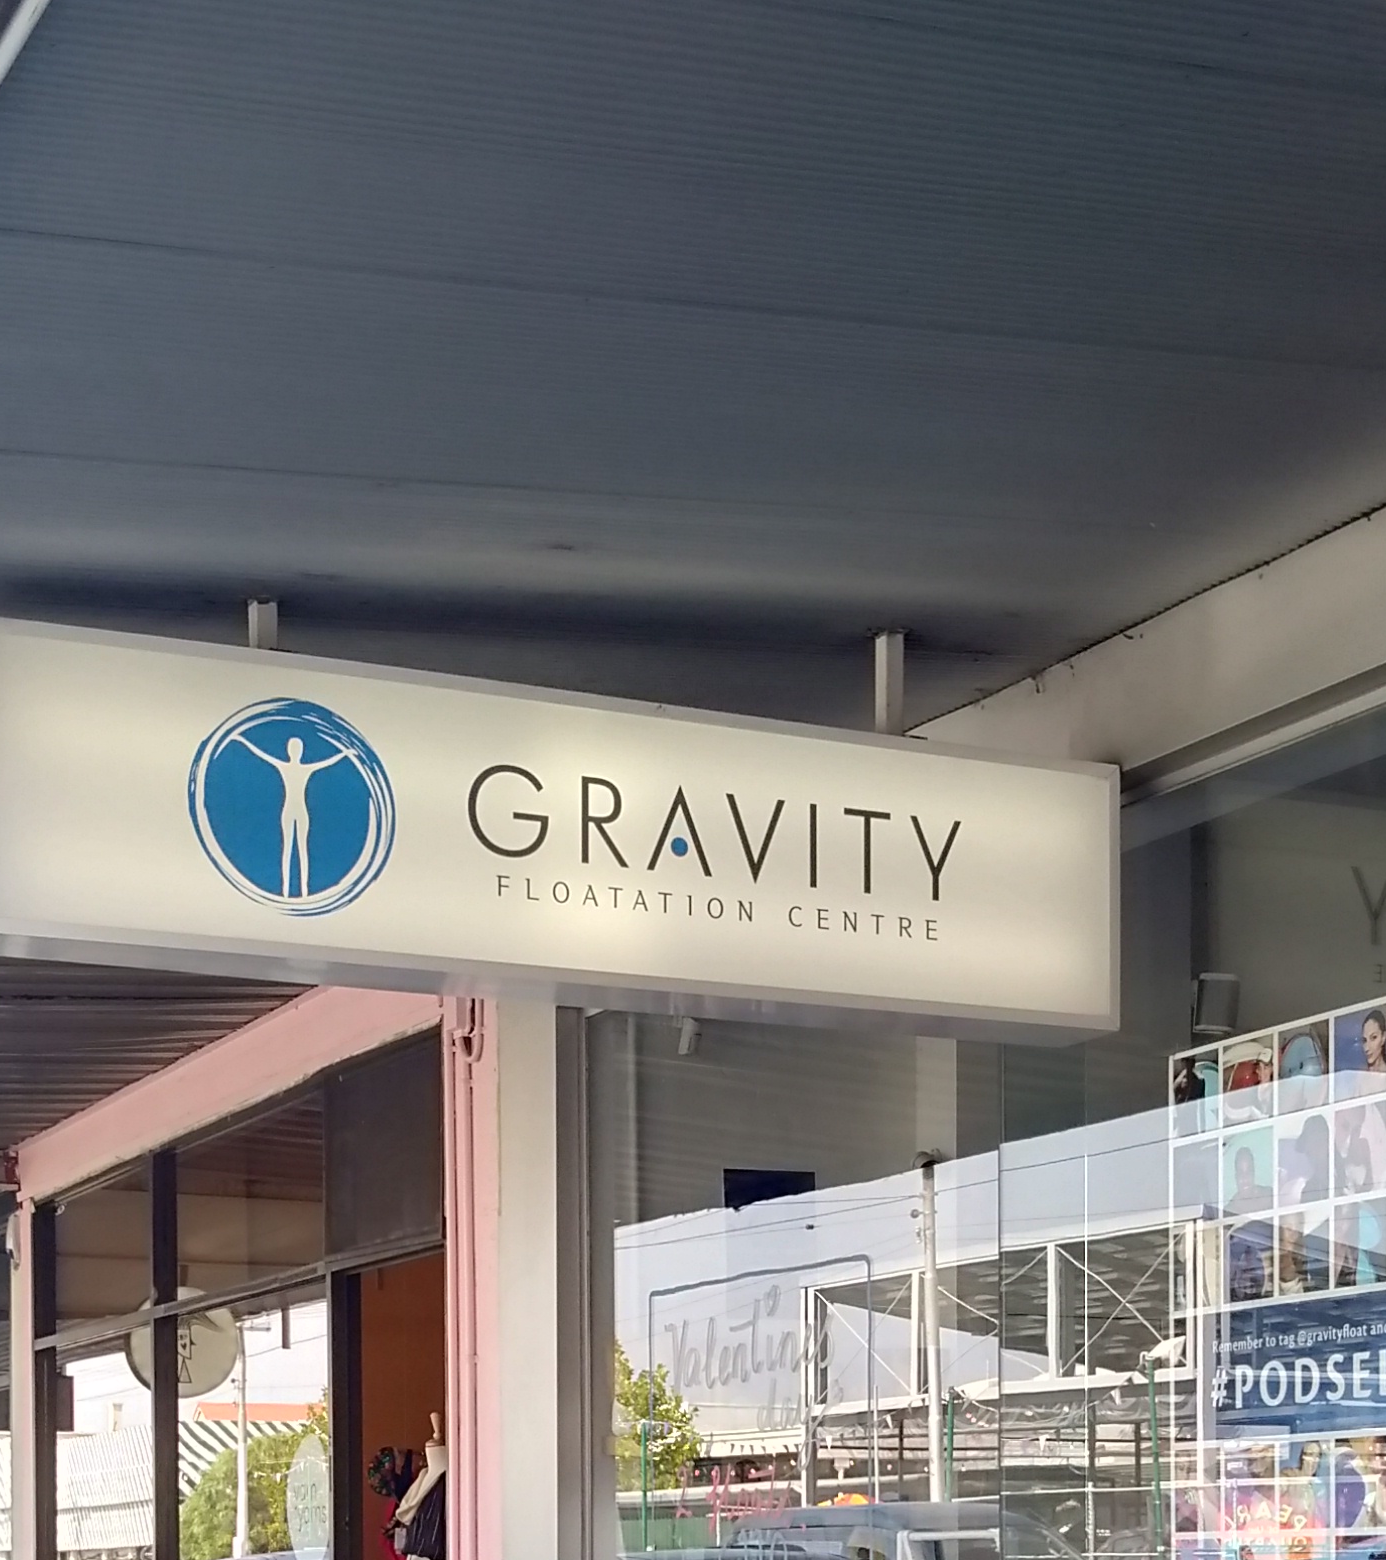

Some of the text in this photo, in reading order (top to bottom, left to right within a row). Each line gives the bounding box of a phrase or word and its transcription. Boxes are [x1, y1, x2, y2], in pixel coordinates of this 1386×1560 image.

[467, 763, 962, 901] GRAVITY
[496, 874, 940, 941] FLOATATION CENTRE
[1212, 1335, 1264, 1354] Remember
[1265, 1335, 1277, 1348] to
[1278, 1333, 1295, 1350] tag
[1297, 1323, 1368, 1347] @gravityfloat
